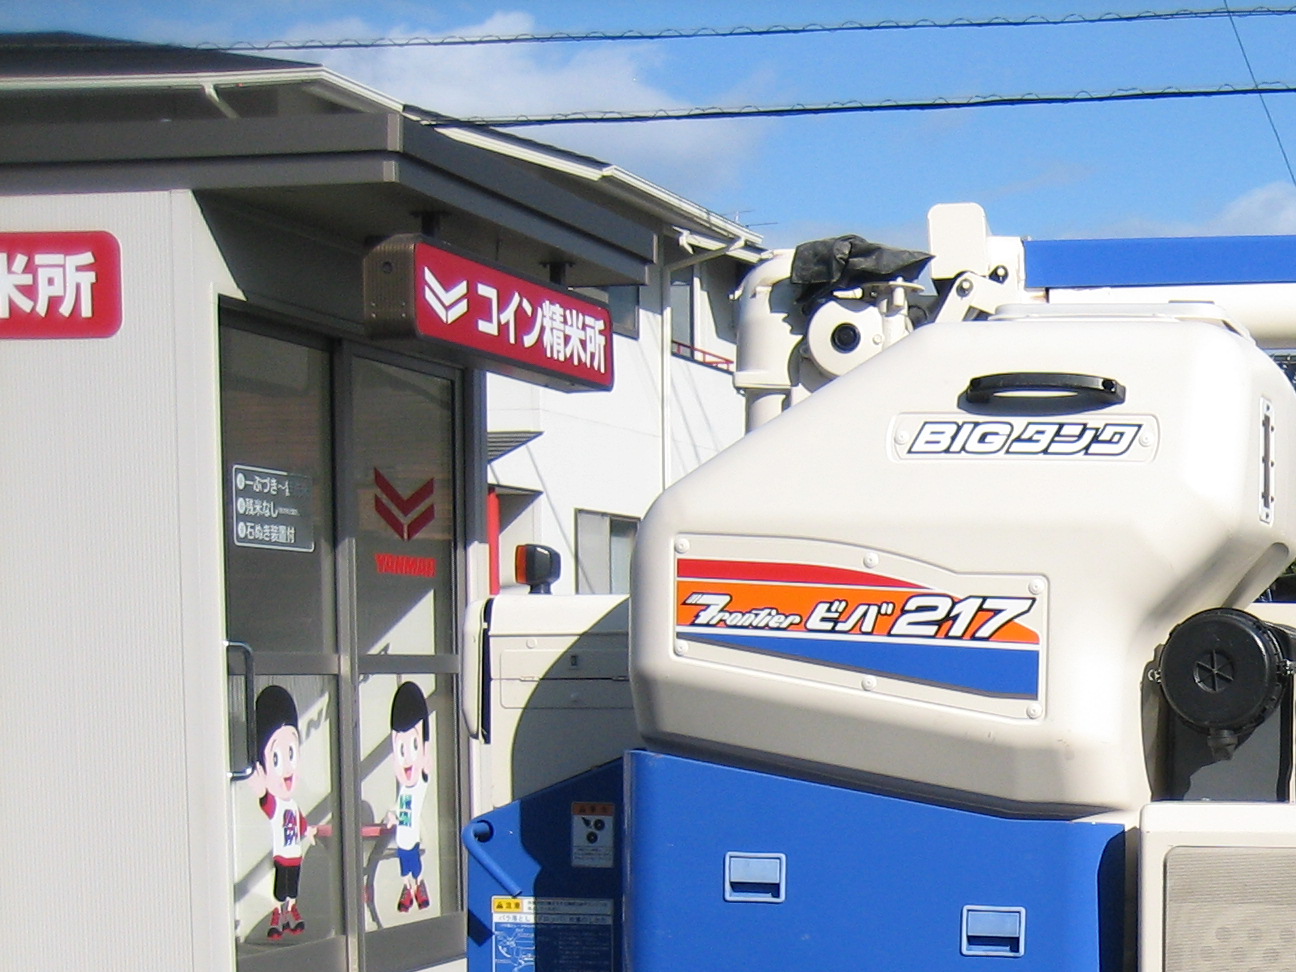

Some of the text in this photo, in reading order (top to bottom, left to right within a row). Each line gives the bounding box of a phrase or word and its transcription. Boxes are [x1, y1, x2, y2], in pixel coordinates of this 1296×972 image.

[477, 282, 606, 374] コイン精米所
[375, 553, 437, 578] YANMAR
[682, 592, 801, 629] Frontier
[888, 594, 1036, 640] 217
